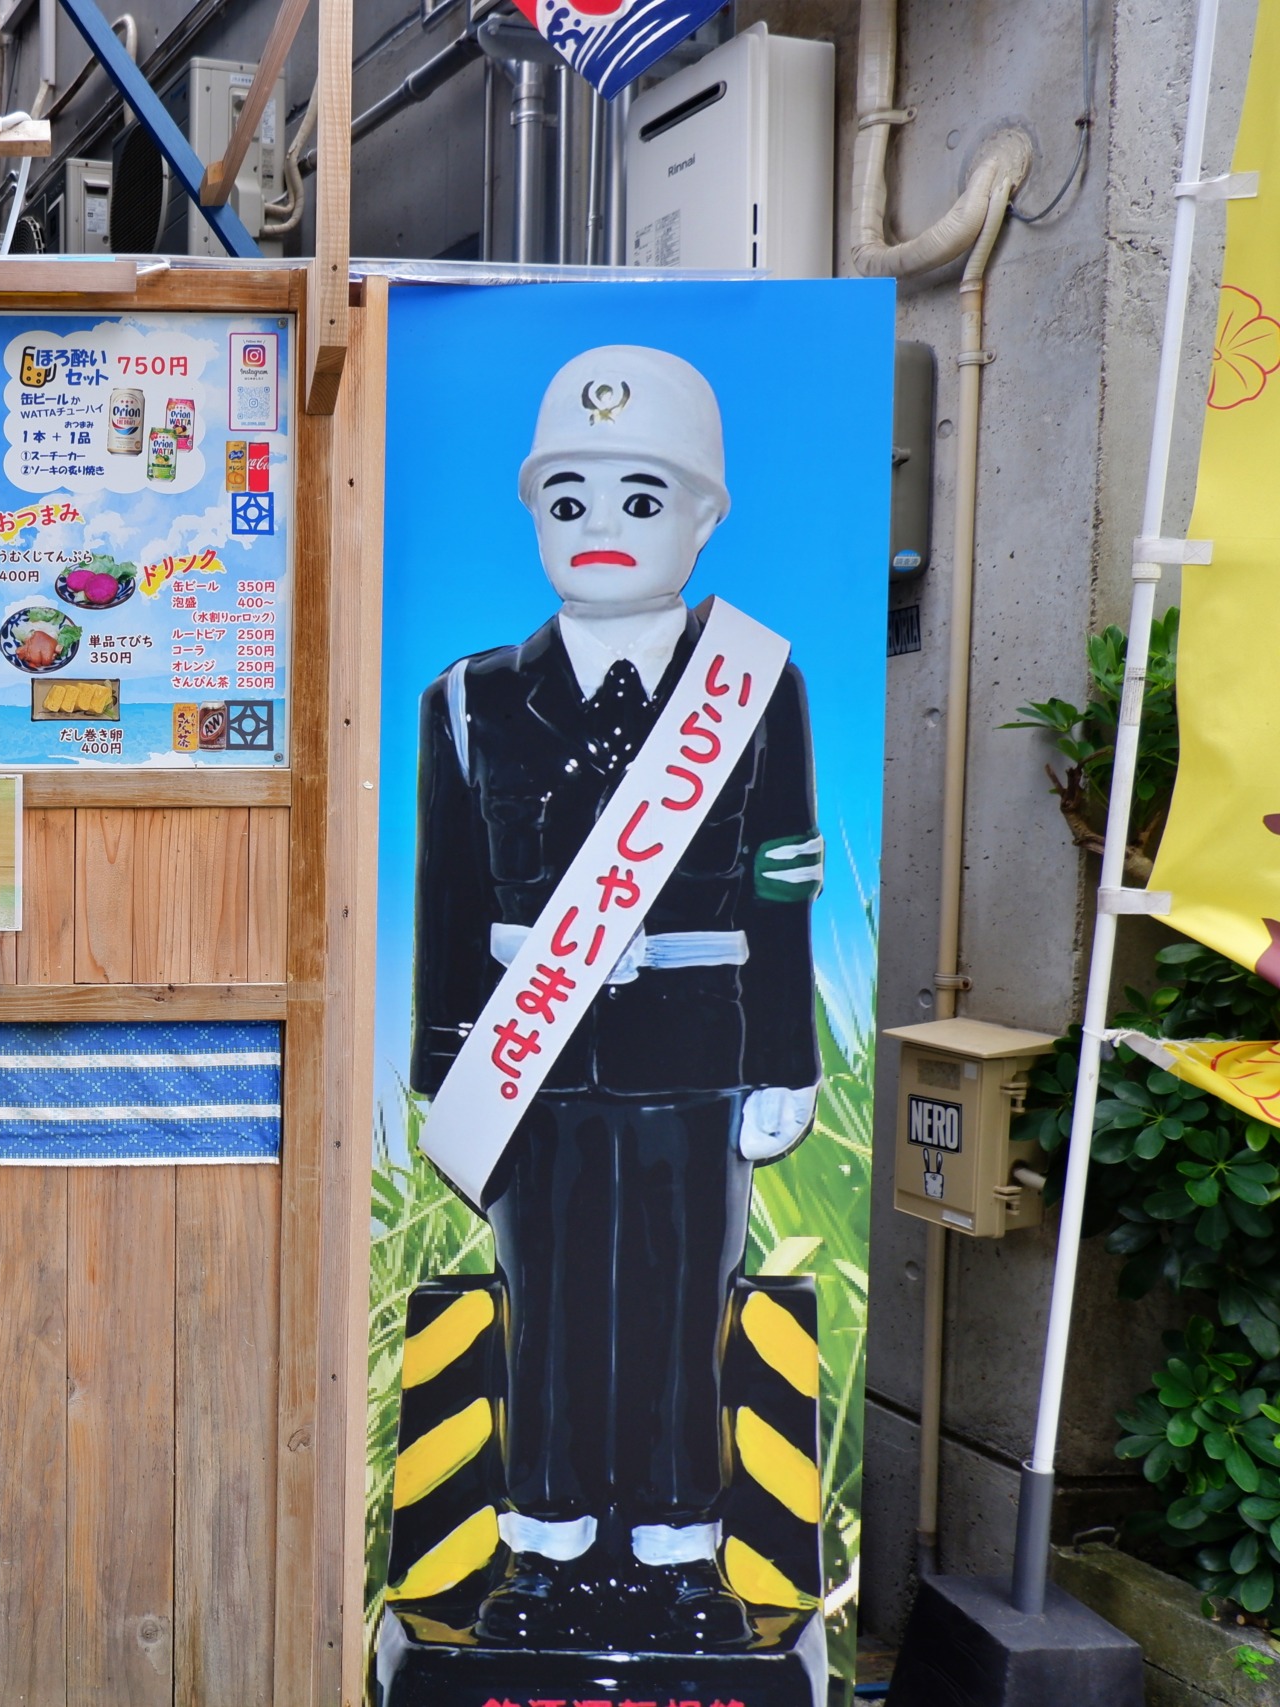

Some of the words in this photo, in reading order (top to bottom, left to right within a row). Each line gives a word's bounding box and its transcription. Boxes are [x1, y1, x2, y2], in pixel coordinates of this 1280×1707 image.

[668, 153, 696, 178] Rinnai
[35, 349, 107, 368] ほろ酔い
[118, 356, 188, 376] 750円
[240, 368, 268, 376] Instagram
[66, 369, 109, 386] セット
[20, 403, 104, 419] WATTAチューハイ
[113, 405, 140, 417] Orion
[171, 410, 190, 418] Orion
[64, 421, 94, 429] おつまみ
[154, 439, 173, 447] Orion
[143, 549, 217, 586] ドリンク
[0, 571, 40, 582] 400円
[172, 581, 219, 593] 缶ビール
[237, 581, 275, 593] 350円
[172, 597, 197, 608] 泡盛
[172, 629, 226, 640] ルートビア
[237, 629, 274, 640] 250円
[88, 635, 153, 648] 単品てびち
[172, 645, 205, 656] コーラ
[90, 651, 132, 664] 350円
[172, 660, 215, 672] オレンジ
[172, 676, 230, 689] さんぴん茶
[60, 729, 123, 742] だし巻き卵
[81, 742, 122, 754] 400円
[492, 654, 752, 1100] いらっしゃいませ。
[911, 1100, 960, 1150] NERO
